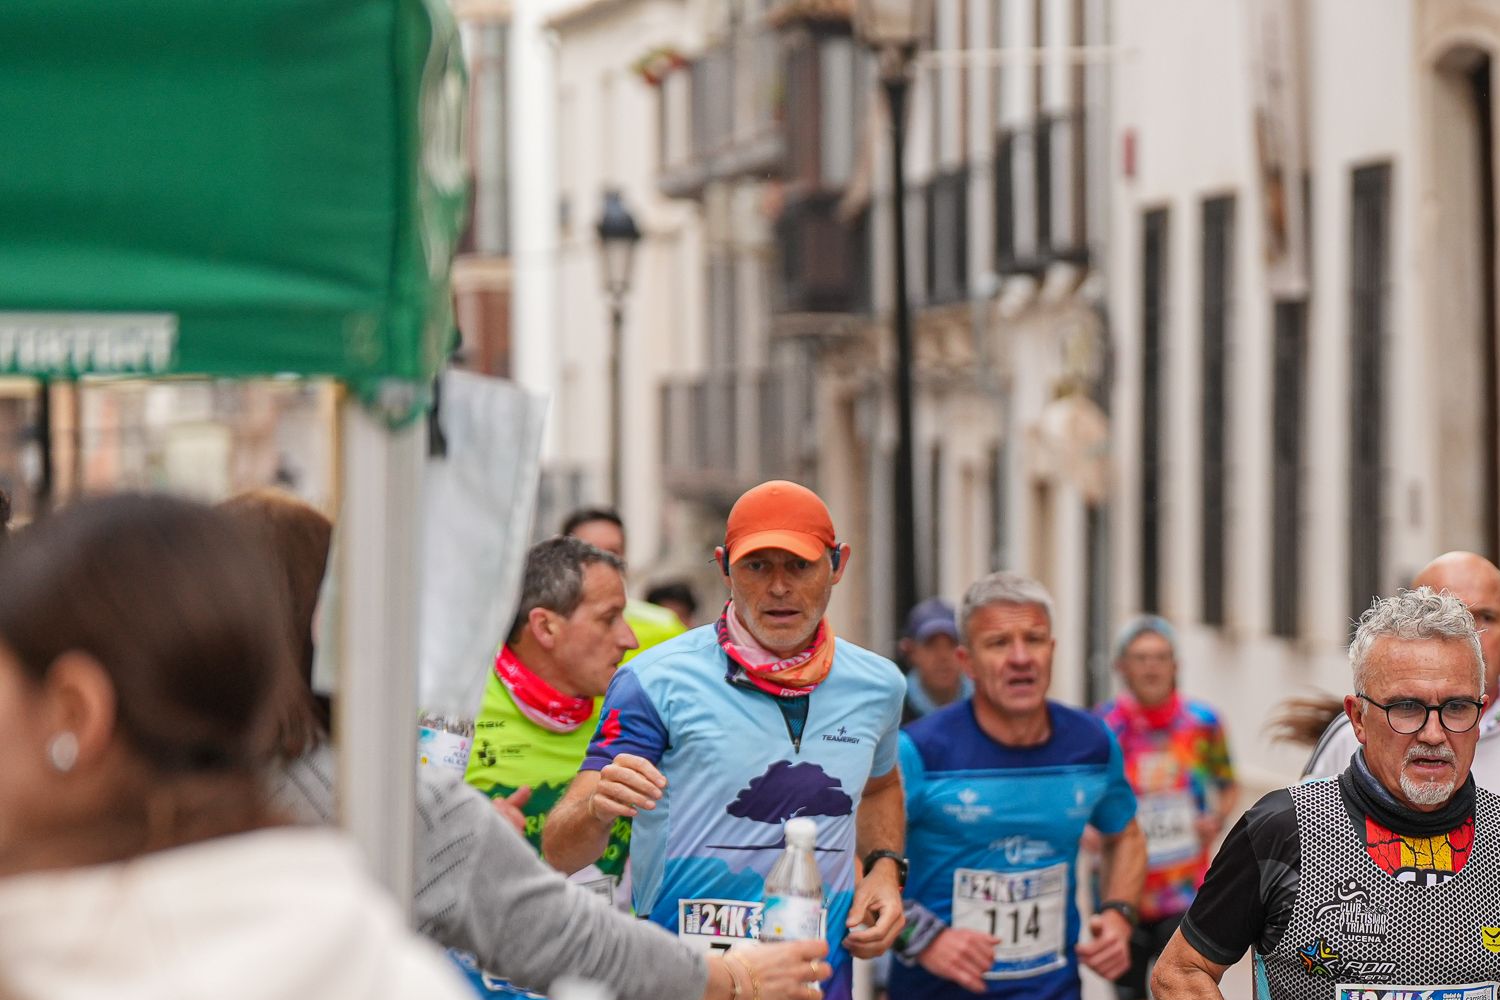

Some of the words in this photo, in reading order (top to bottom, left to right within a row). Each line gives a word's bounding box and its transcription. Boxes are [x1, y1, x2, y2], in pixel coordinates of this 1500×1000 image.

[822, 734, 860, 744] TEAMERGY
[1340, 902, 1361, 913] CLUB
[701, 904, 746, 936] 21K
[985, 903, 1040, 944] 114
[1340, 912, 1387, 925] ATLETISMO
[1342, 934, 1381, 943] LUCENA
